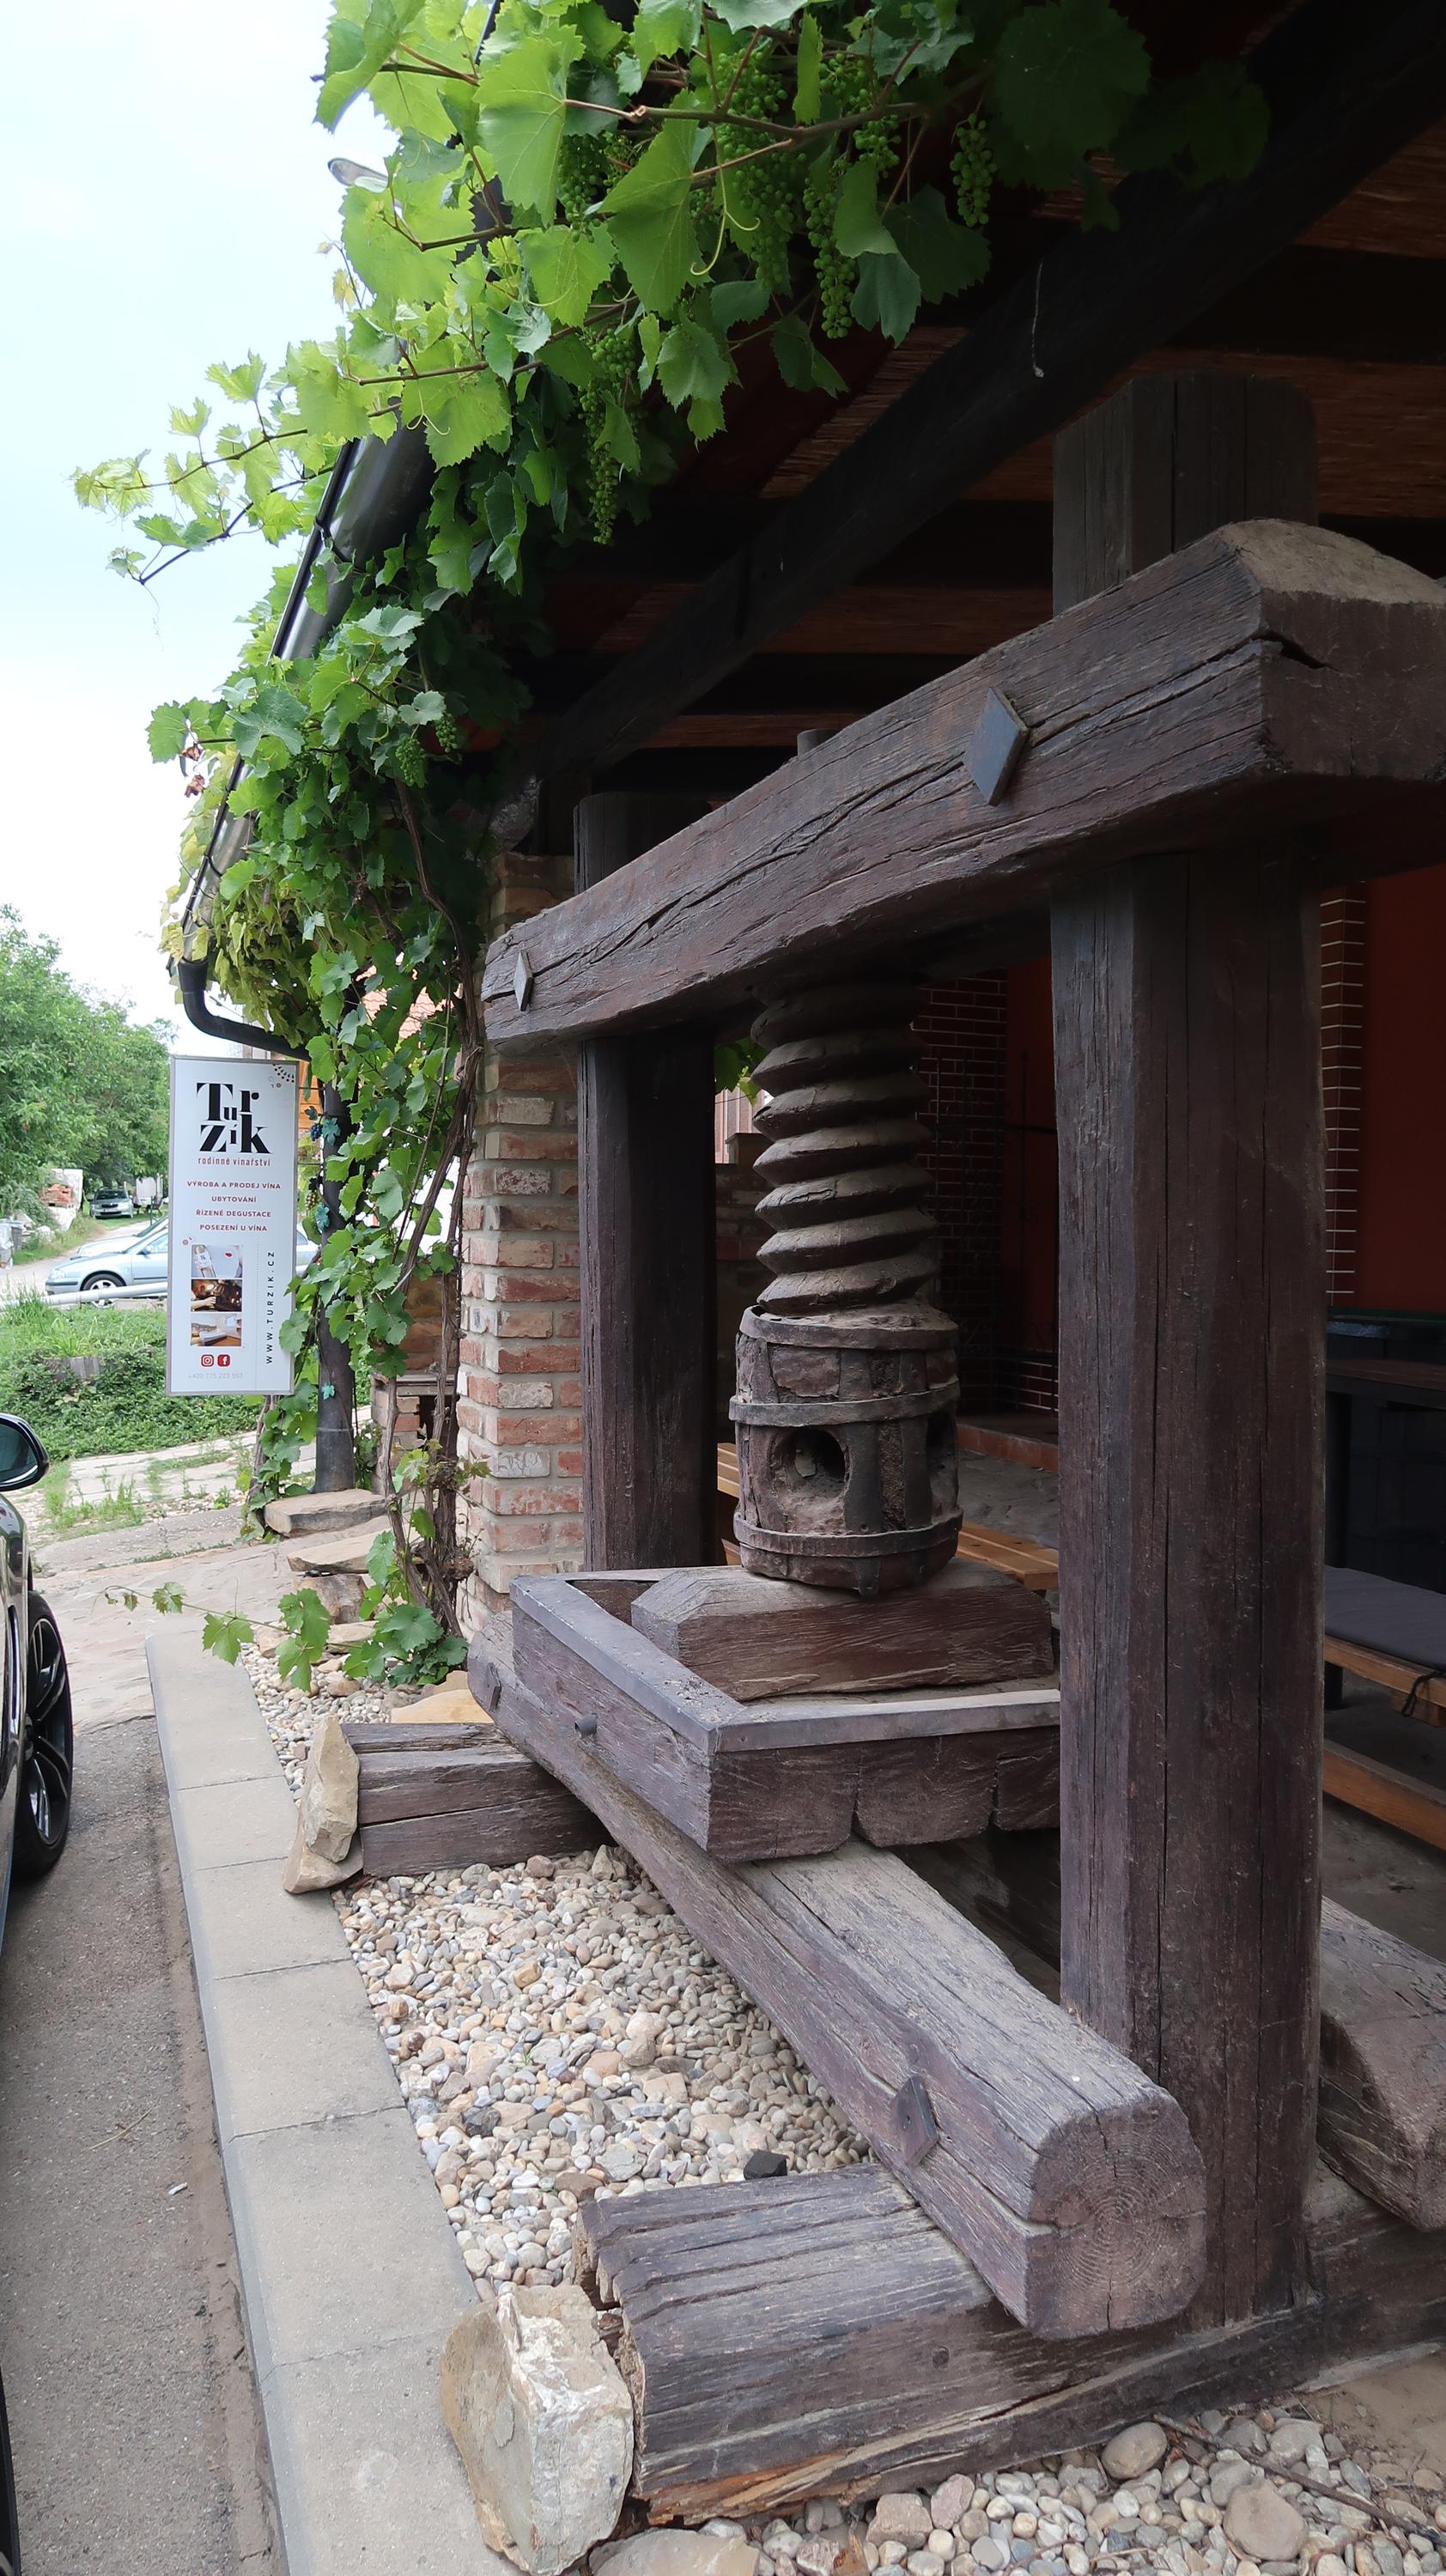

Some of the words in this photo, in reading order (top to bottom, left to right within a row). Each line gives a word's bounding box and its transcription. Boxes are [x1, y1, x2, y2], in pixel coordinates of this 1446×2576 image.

[198, 1157, 230, 1165] rodinné
[233, 1157, 270, 1166] vinařství
[266, 1251, 275, 1364] WWW.TURZIK.CZ
